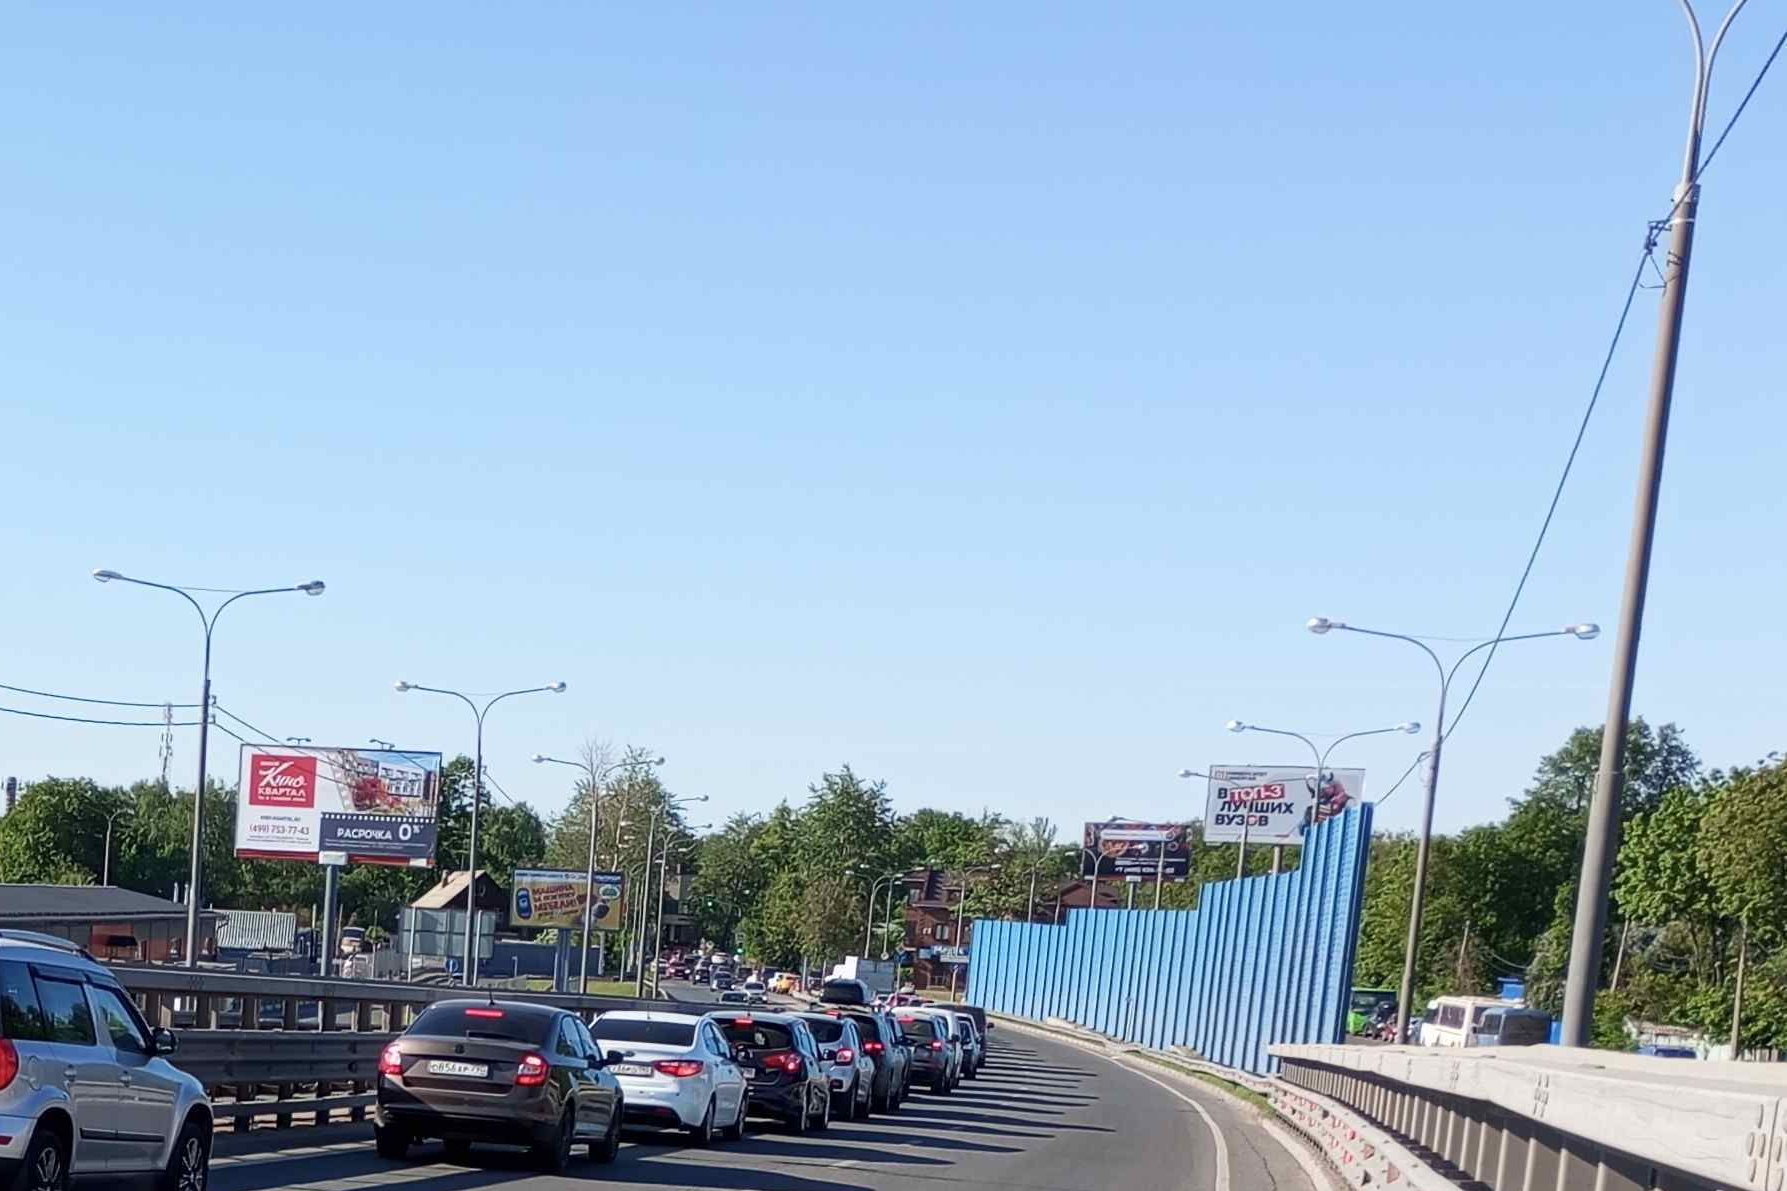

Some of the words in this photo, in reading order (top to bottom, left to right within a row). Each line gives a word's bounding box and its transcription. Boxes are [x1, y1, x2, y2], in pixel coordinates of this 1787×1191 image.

[258, 787, 306, 797] КВАРТАЛ
[1217, 787, 1228, 799] В
[1232, 785, 1282, 801] ТОП-3
[1219, 800, 1295, 814] ЛУЧШИХ
[1214, 814, 1269, 827] ВУЗОВ
